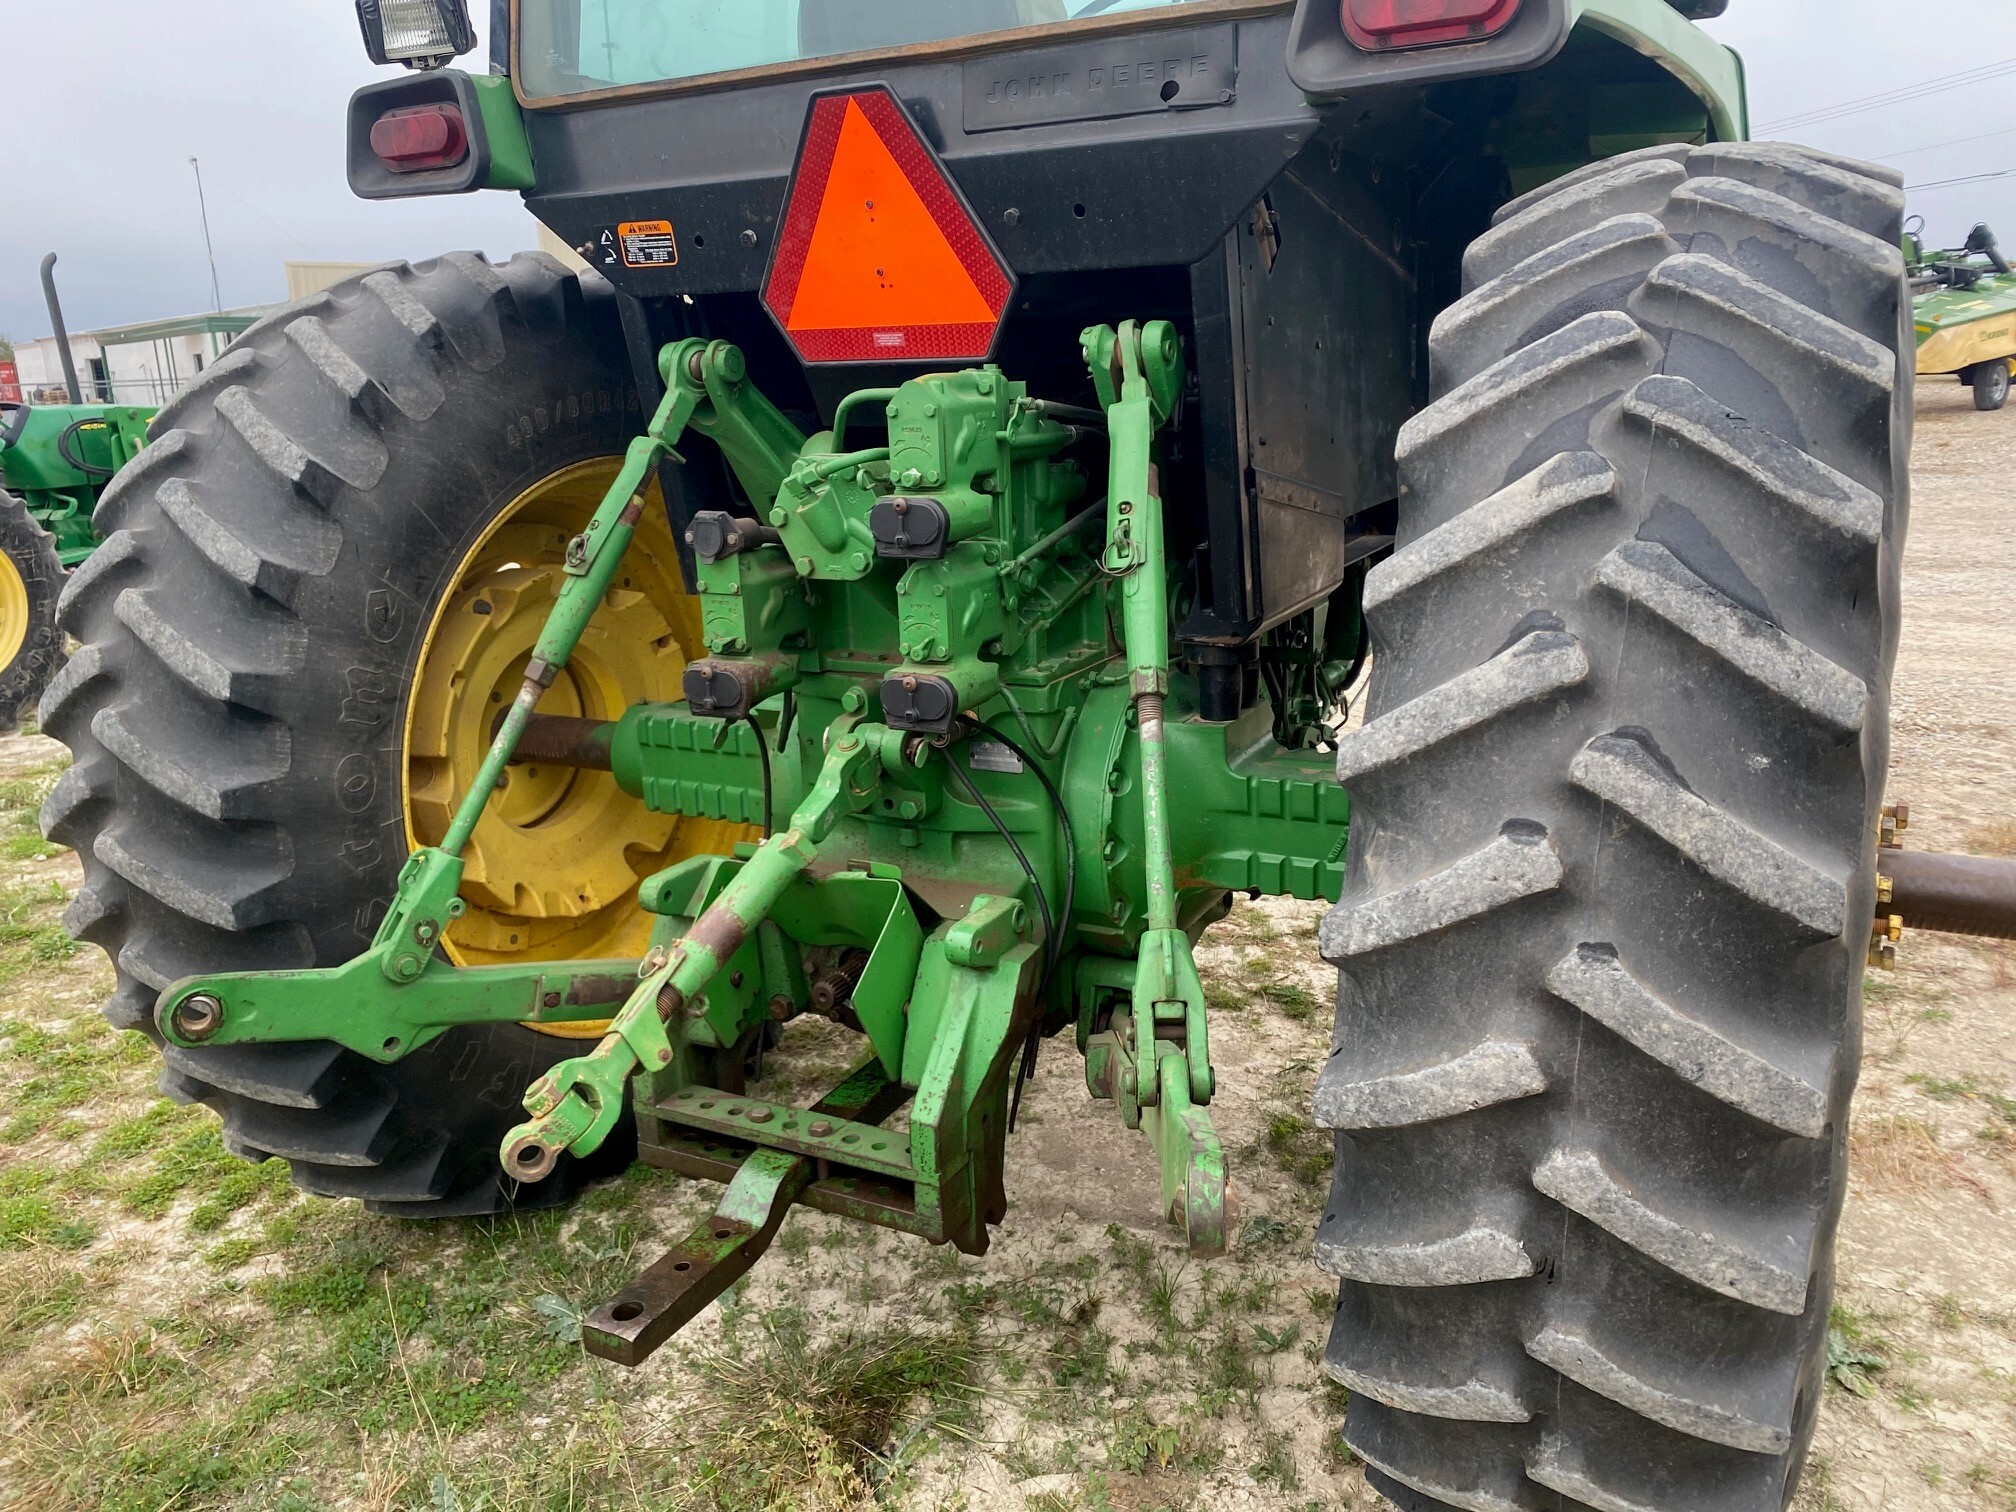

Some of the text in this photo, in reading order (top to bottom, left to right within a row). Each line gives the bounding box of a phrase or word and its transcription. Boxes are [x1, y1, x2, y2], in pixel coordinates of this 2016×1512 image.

[986, 54, 1208, 104] JOHN DEERE
[637, 223, 662, 233] WARNING
